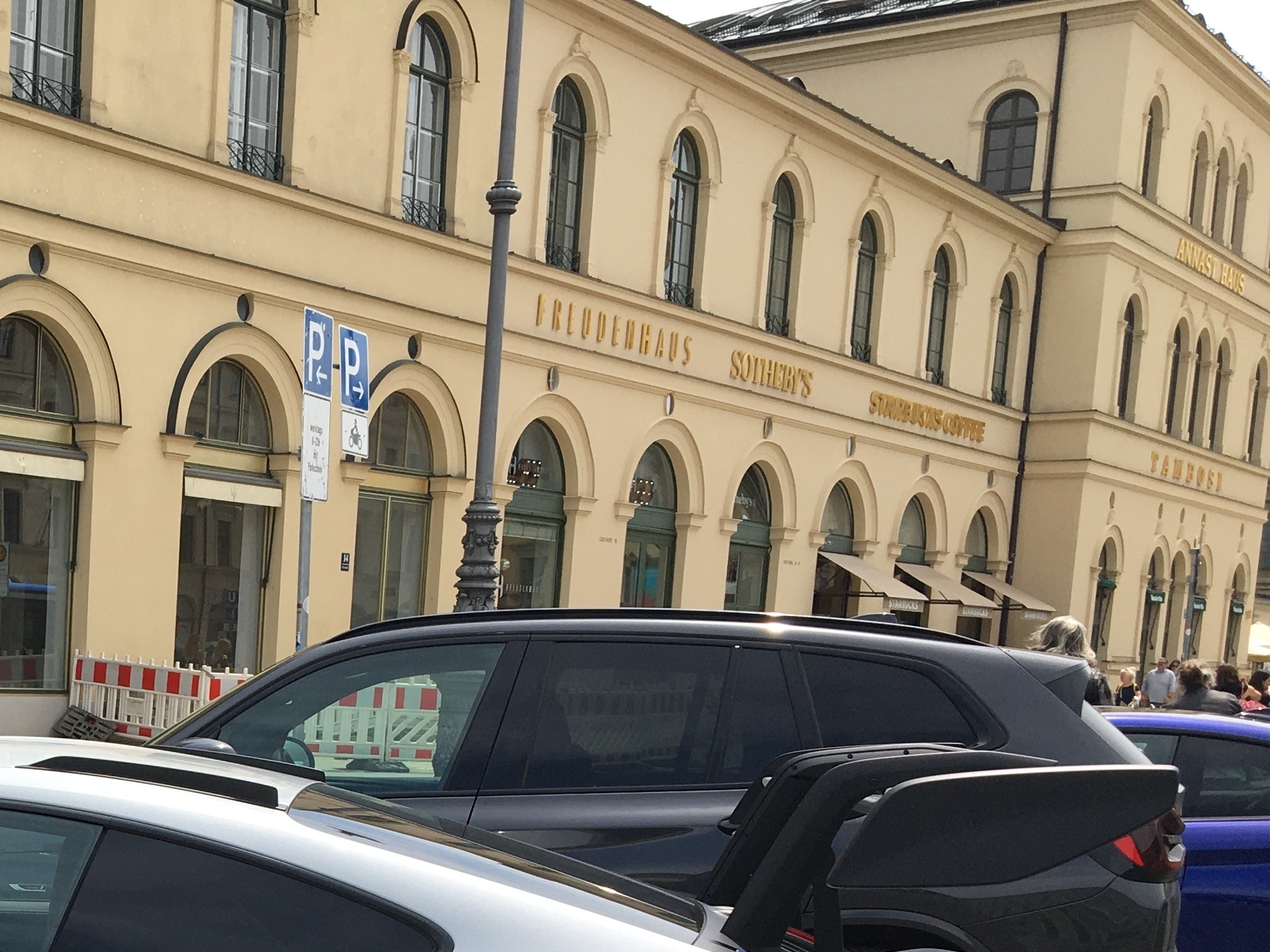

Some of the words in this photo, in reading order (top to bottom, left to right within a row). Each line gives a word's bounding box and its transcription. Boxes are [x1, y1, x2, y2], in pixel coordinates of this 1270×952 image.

[1175, 237, 1218, 279] ANNAST
[1220, 263, 1245, 295] HAUS
[309, 321, 325, 382] P
[535, 293, 693, 365] FREUDENHAUS
[344, 338, 360, 396] P
[729, 349, 814, 399] SOTHEBY'S
[869, 390, 943, 432] STARBUCKS
[943, 412, 986, 443] COFFEE
[1151, 450, 1223, 492] TAMBOSI
[888, 599, 919, 611] STARBUCKS
[962, 606, 989, 617] STARBUCKS
